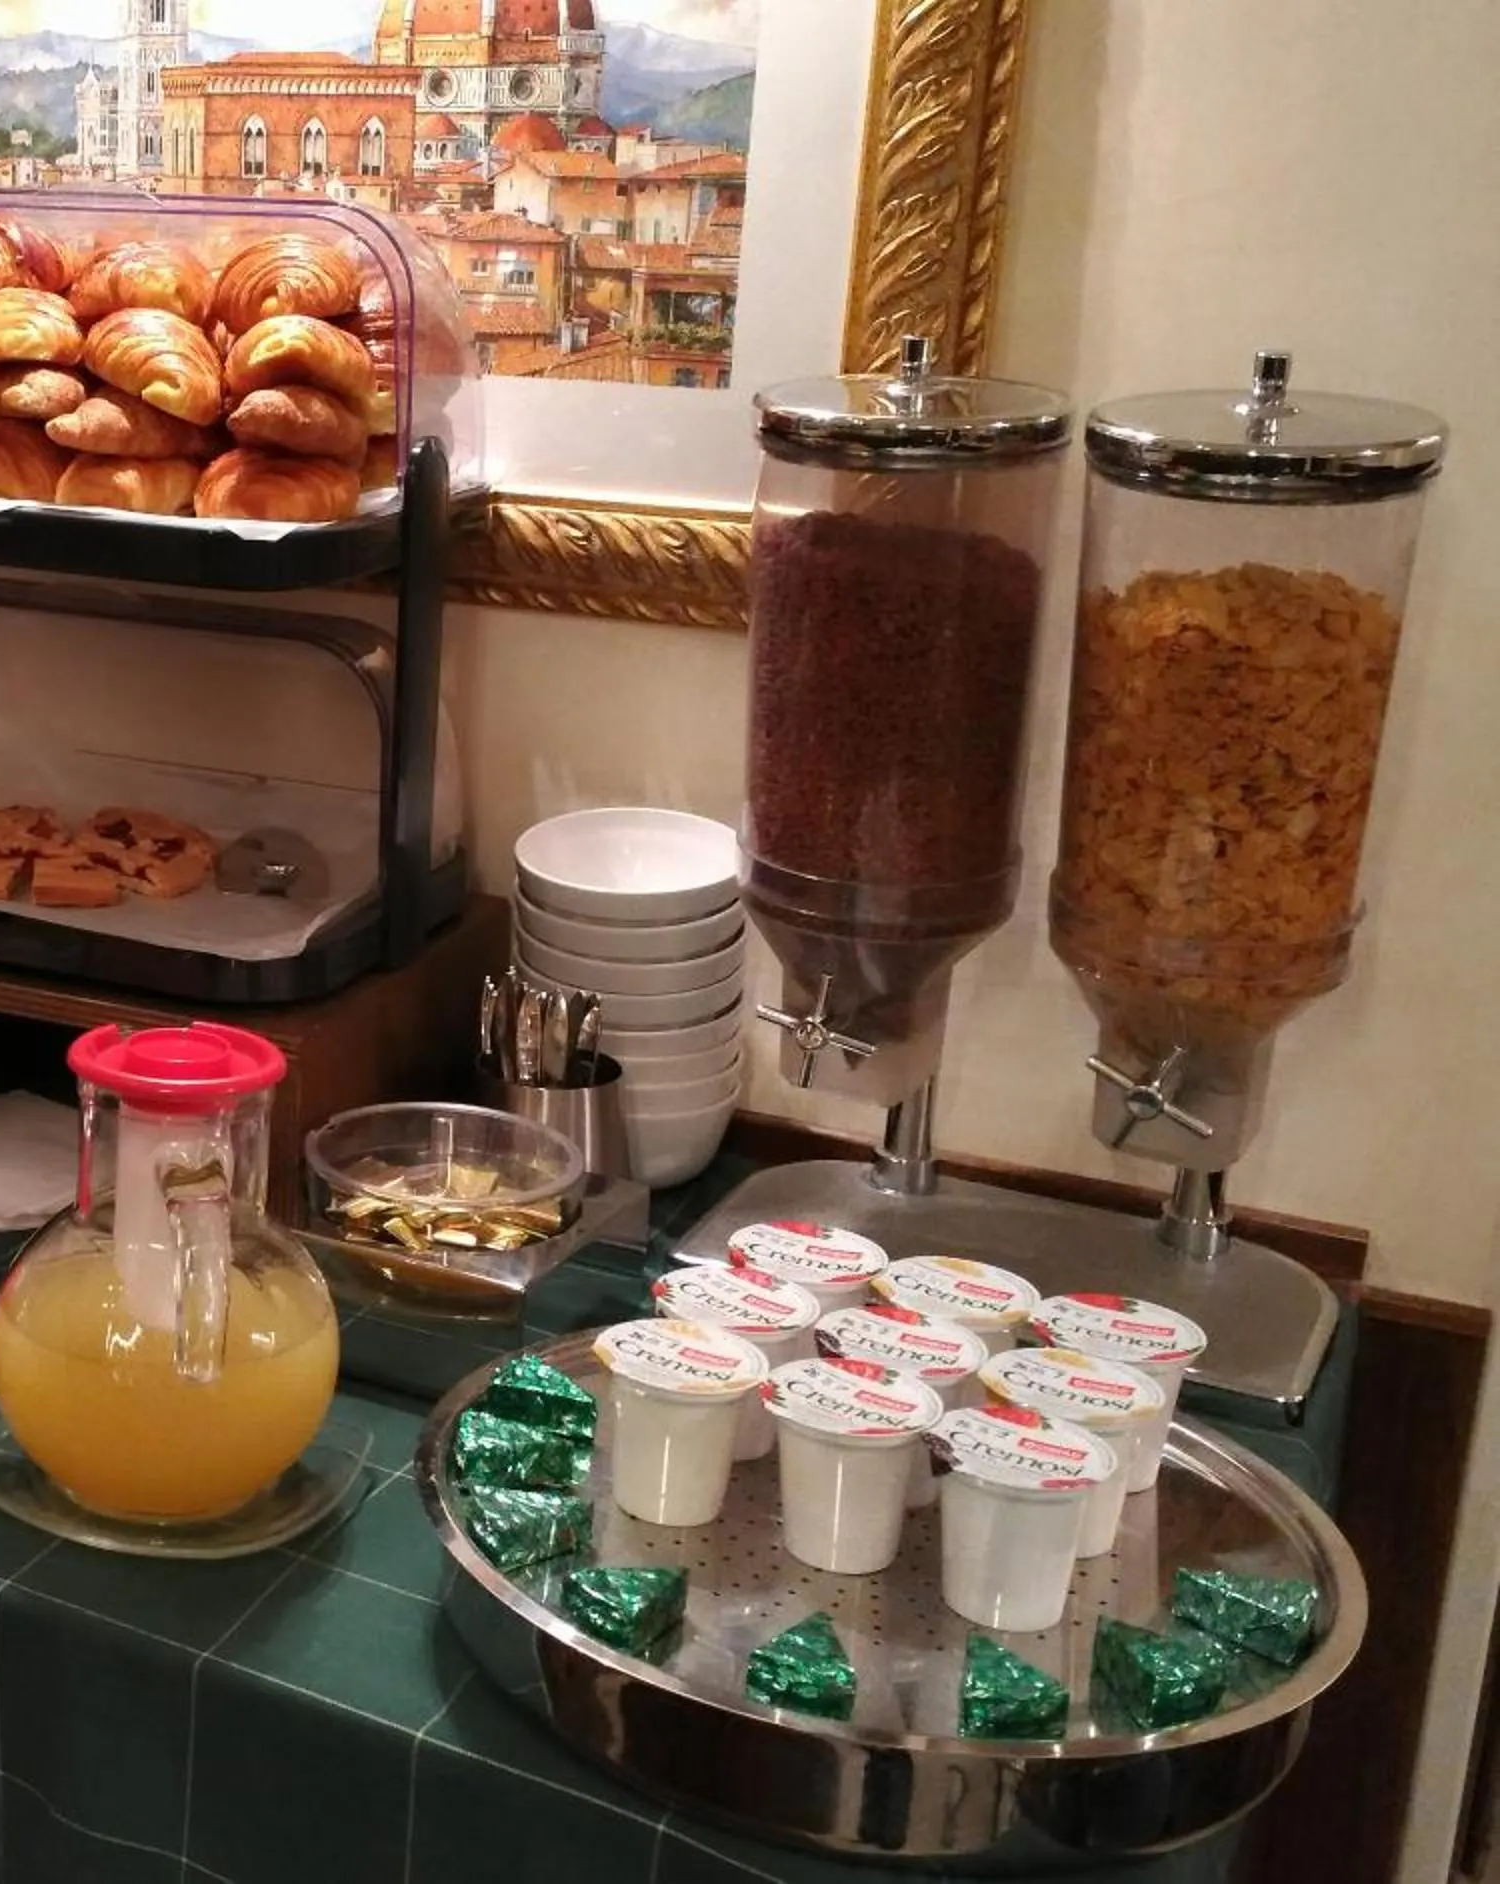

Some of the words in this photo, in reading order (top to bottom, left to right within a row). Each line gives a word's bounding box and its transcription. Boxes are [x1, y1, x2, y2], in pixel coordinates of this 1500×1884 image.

[615, 1338, 734, 1381] Cremosi
[786, 1380, 907, 1427] Cremosi
[1002, 1370, 1134, 1411] Cremosi
[949, 1430, 1086, 1478] Cremosi
